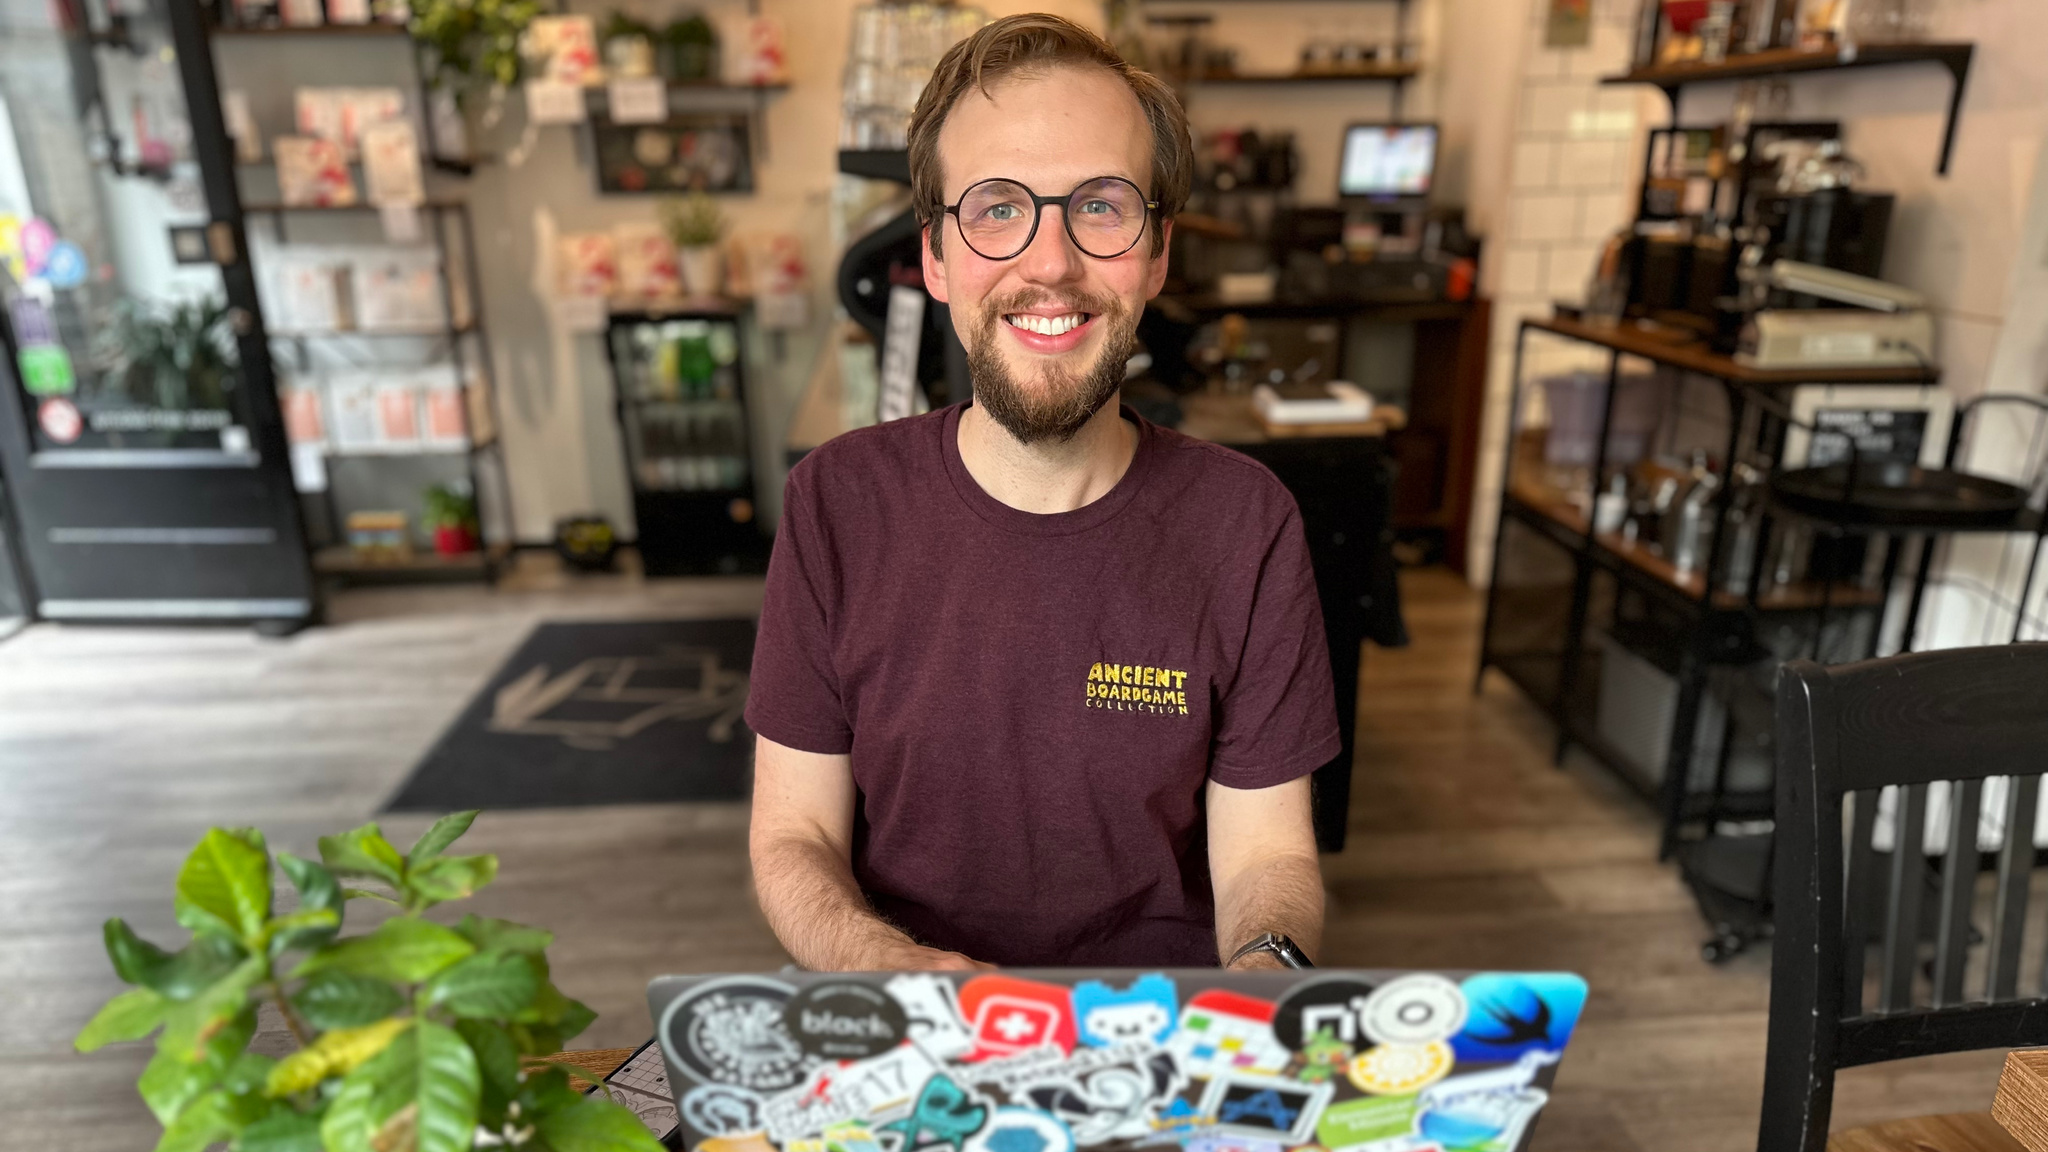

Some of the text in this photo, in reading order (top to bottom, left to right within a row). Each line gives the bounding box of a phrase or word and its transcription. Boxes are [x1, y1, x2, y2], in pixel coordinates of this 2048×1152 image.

[1087, 662, 1188, 689] ANCIENT
[1086, 681, 1187, 705] BOARDGAME
[1085, 698, 1189, 715] COLLECTION
